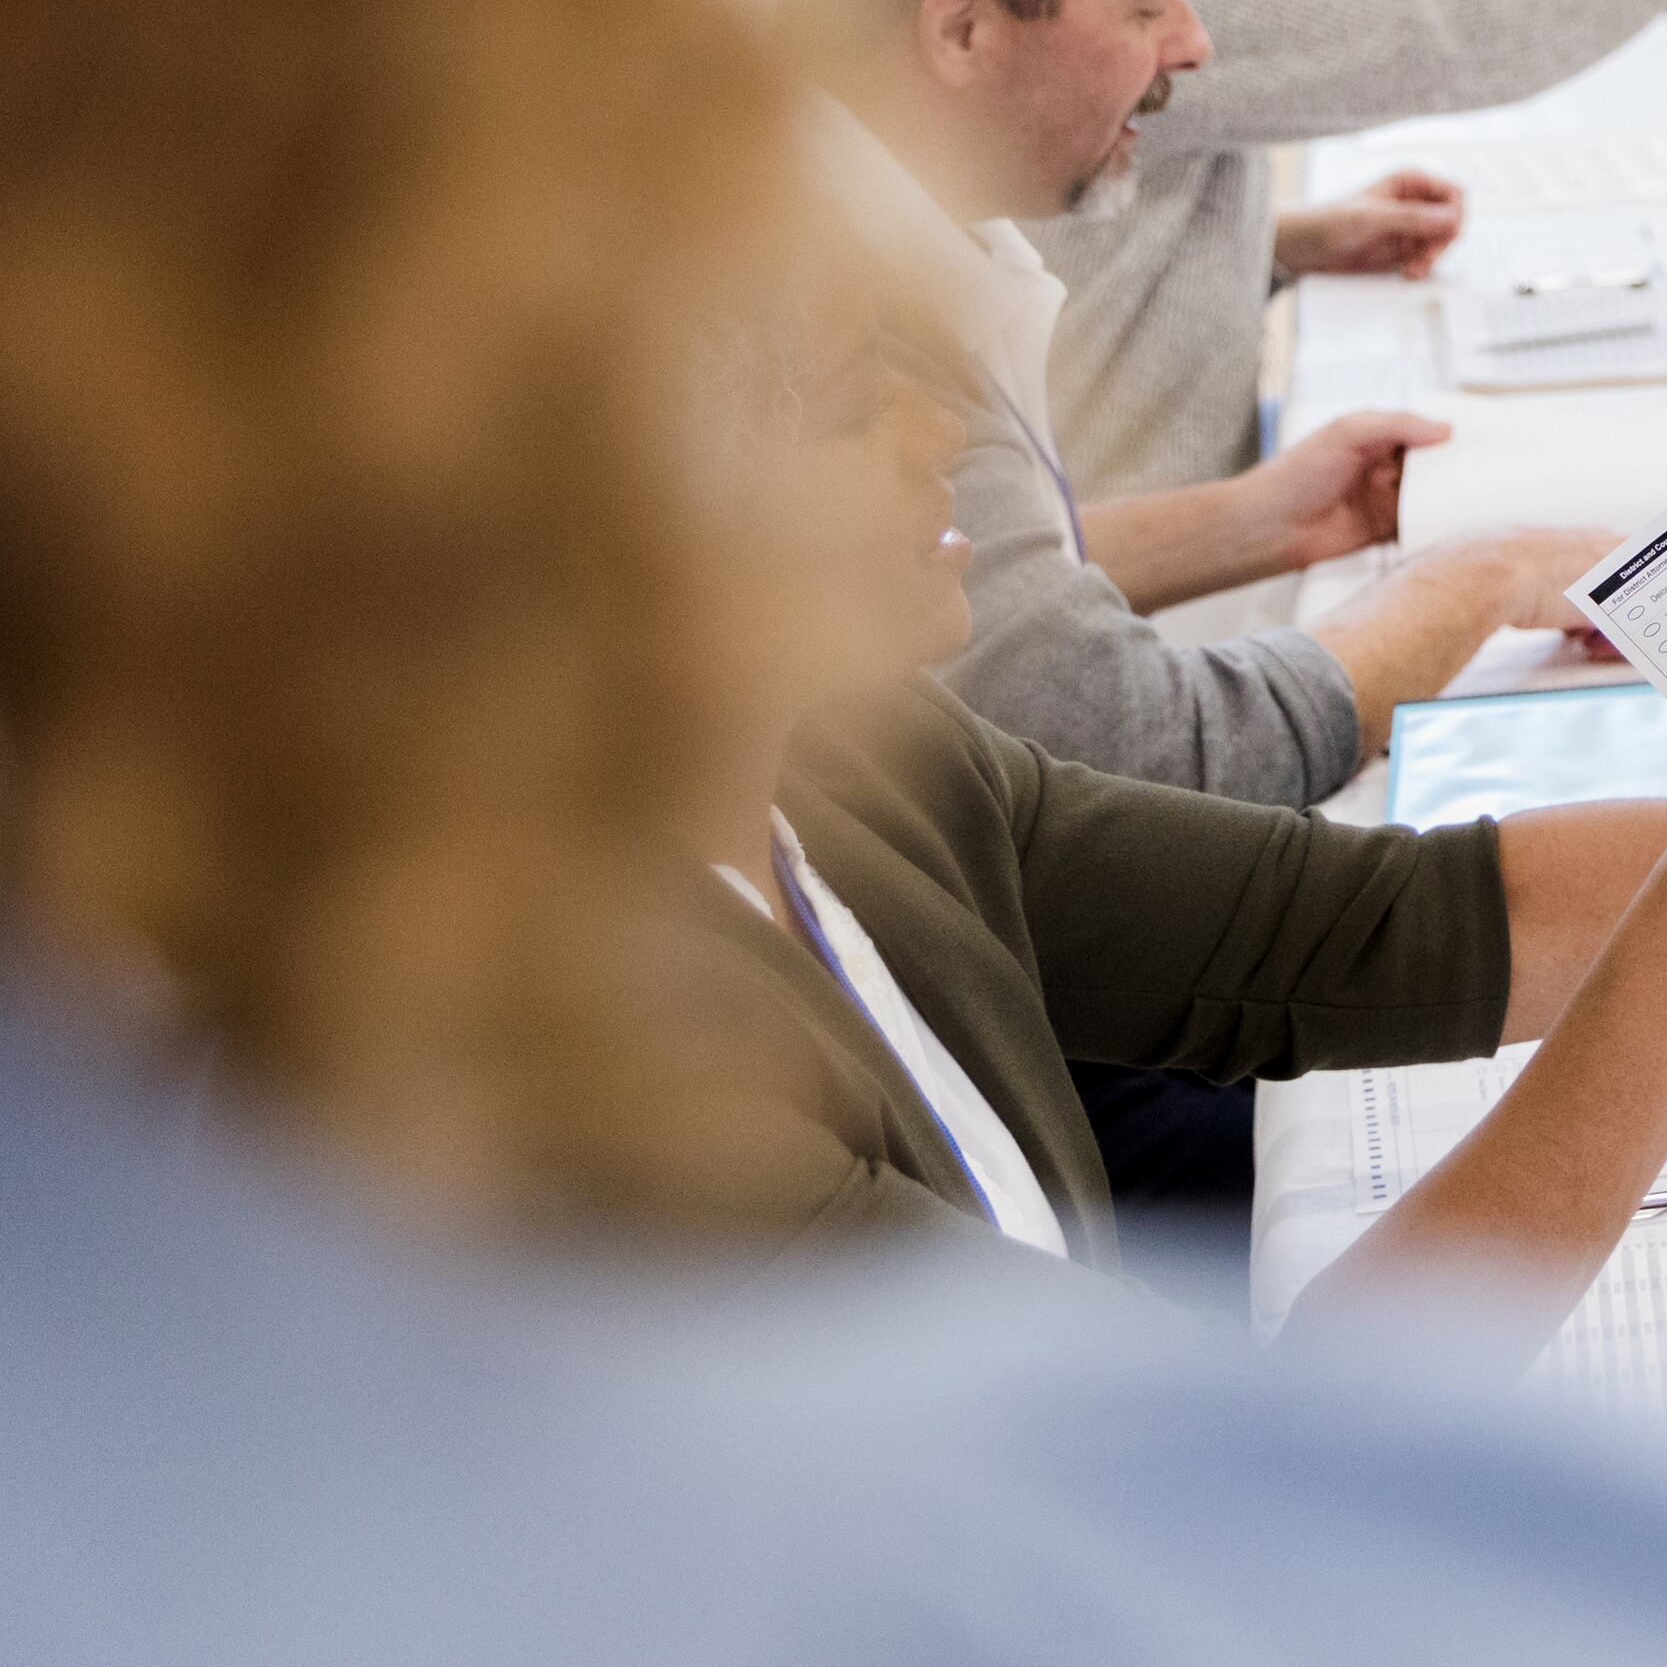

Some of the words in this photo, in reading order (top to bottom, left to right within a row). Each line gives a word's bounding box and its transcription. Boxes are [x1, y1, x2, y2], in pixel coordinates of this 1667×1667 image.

[1619, 558, 1644, 580] District
[1643, 548, 1657, 562] and
[1612, 594, 1625, 605] For
[1623, 575, 1648, 596] District
